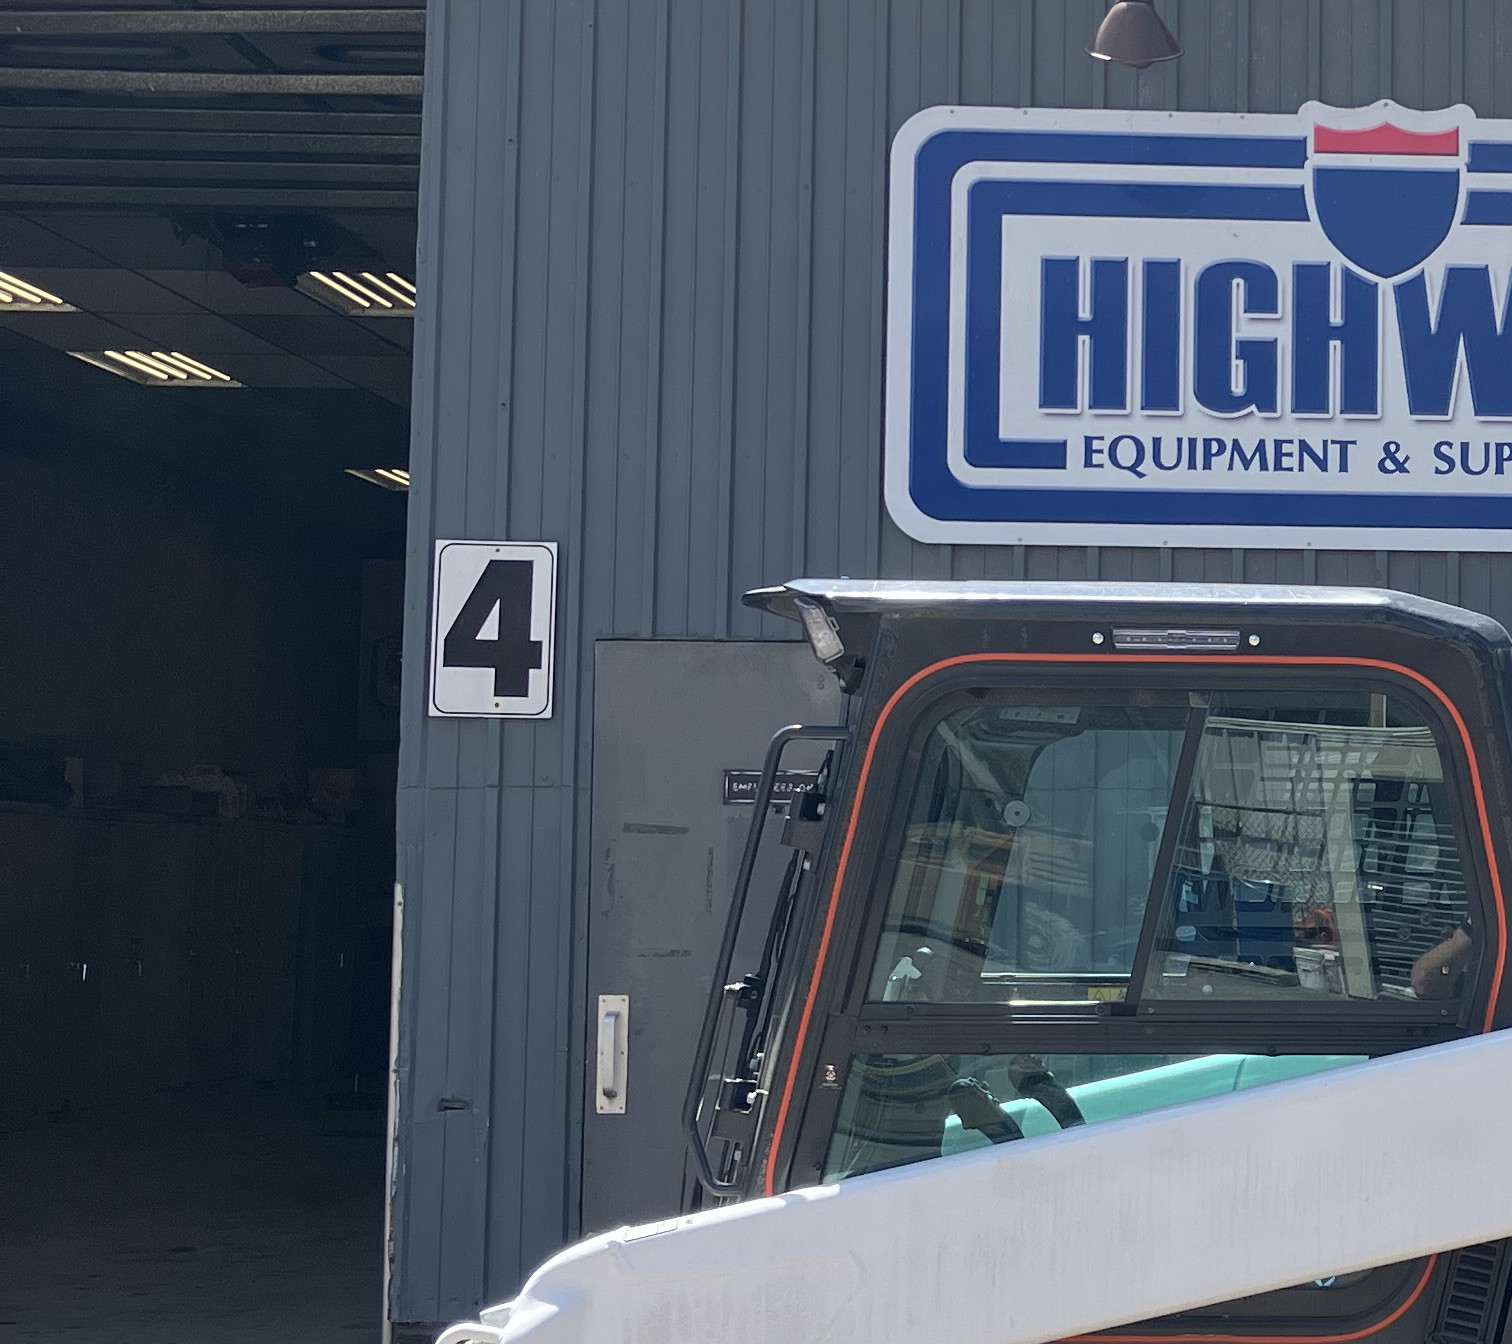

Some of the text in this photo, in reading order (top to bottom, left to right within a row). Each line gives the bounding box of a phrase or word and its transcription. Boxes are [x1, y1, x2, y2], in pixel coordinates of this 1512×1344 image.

[1082, 433, 1357, 478] EQUIPMENT
[1377, 440, 1411, 474] &
[443, 560, 542, 697] 4
